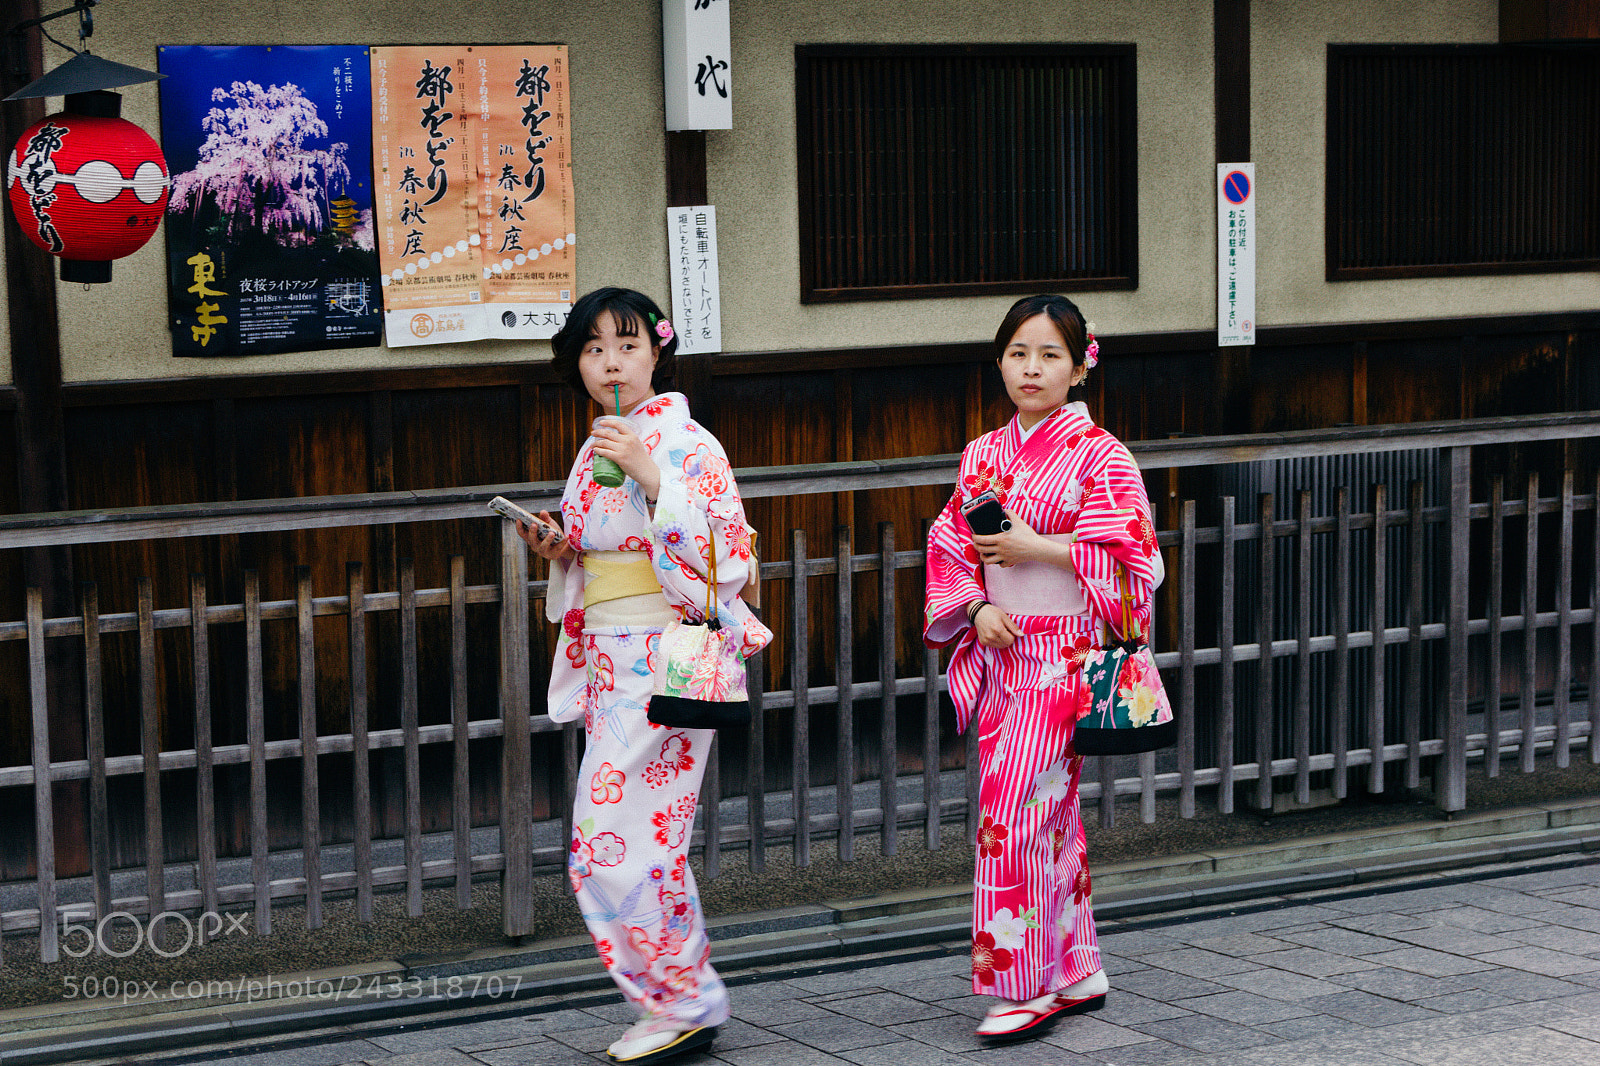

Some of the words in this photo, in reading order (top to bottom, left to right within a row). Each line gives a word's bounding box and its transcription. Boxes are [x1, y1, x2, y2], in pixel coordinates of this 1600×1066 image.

[415, 59, 455, 207] 都をどり
[515, 58, 553, 203] 都をどり
[395, 165, 427, 259] 春秋座
[496, 163, 527, 254] 春秋座
[239, 277, 318, 294] 夜桜ライトアップ
